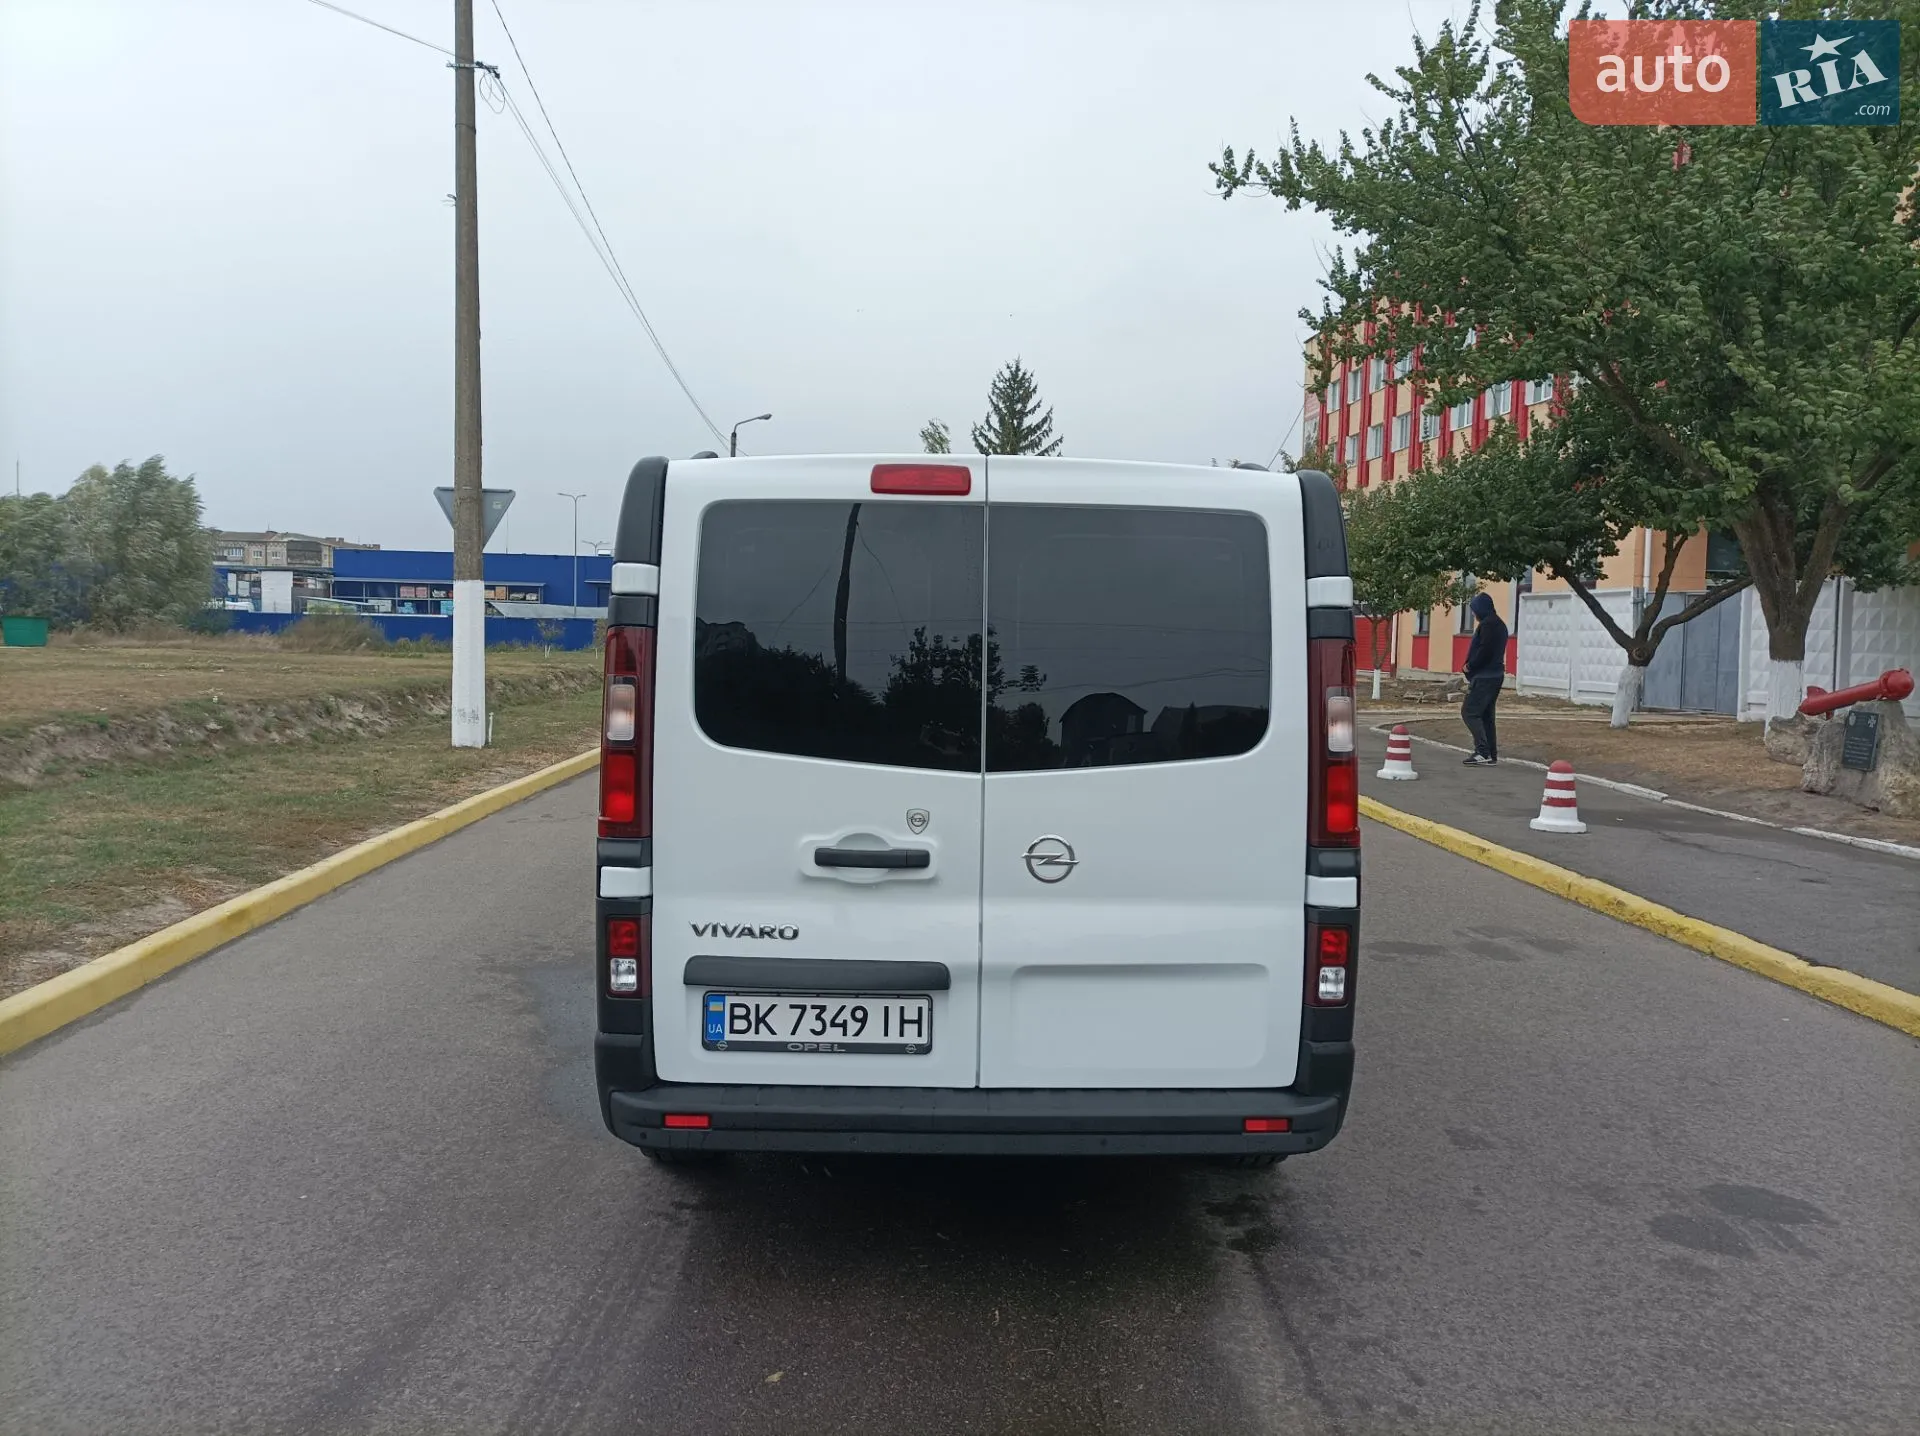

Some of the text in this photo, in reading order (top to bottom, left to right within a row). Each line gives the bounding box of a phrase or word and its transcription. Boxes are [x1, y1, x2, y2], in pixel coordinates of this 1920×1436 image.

[689, 920, 800, 941] VIVARO
[728, 1002, 923, 1038] BK 7349 IH
[708, 1023, 723, 1035] UA
[787, 1043, 846, 1052] OPEL
